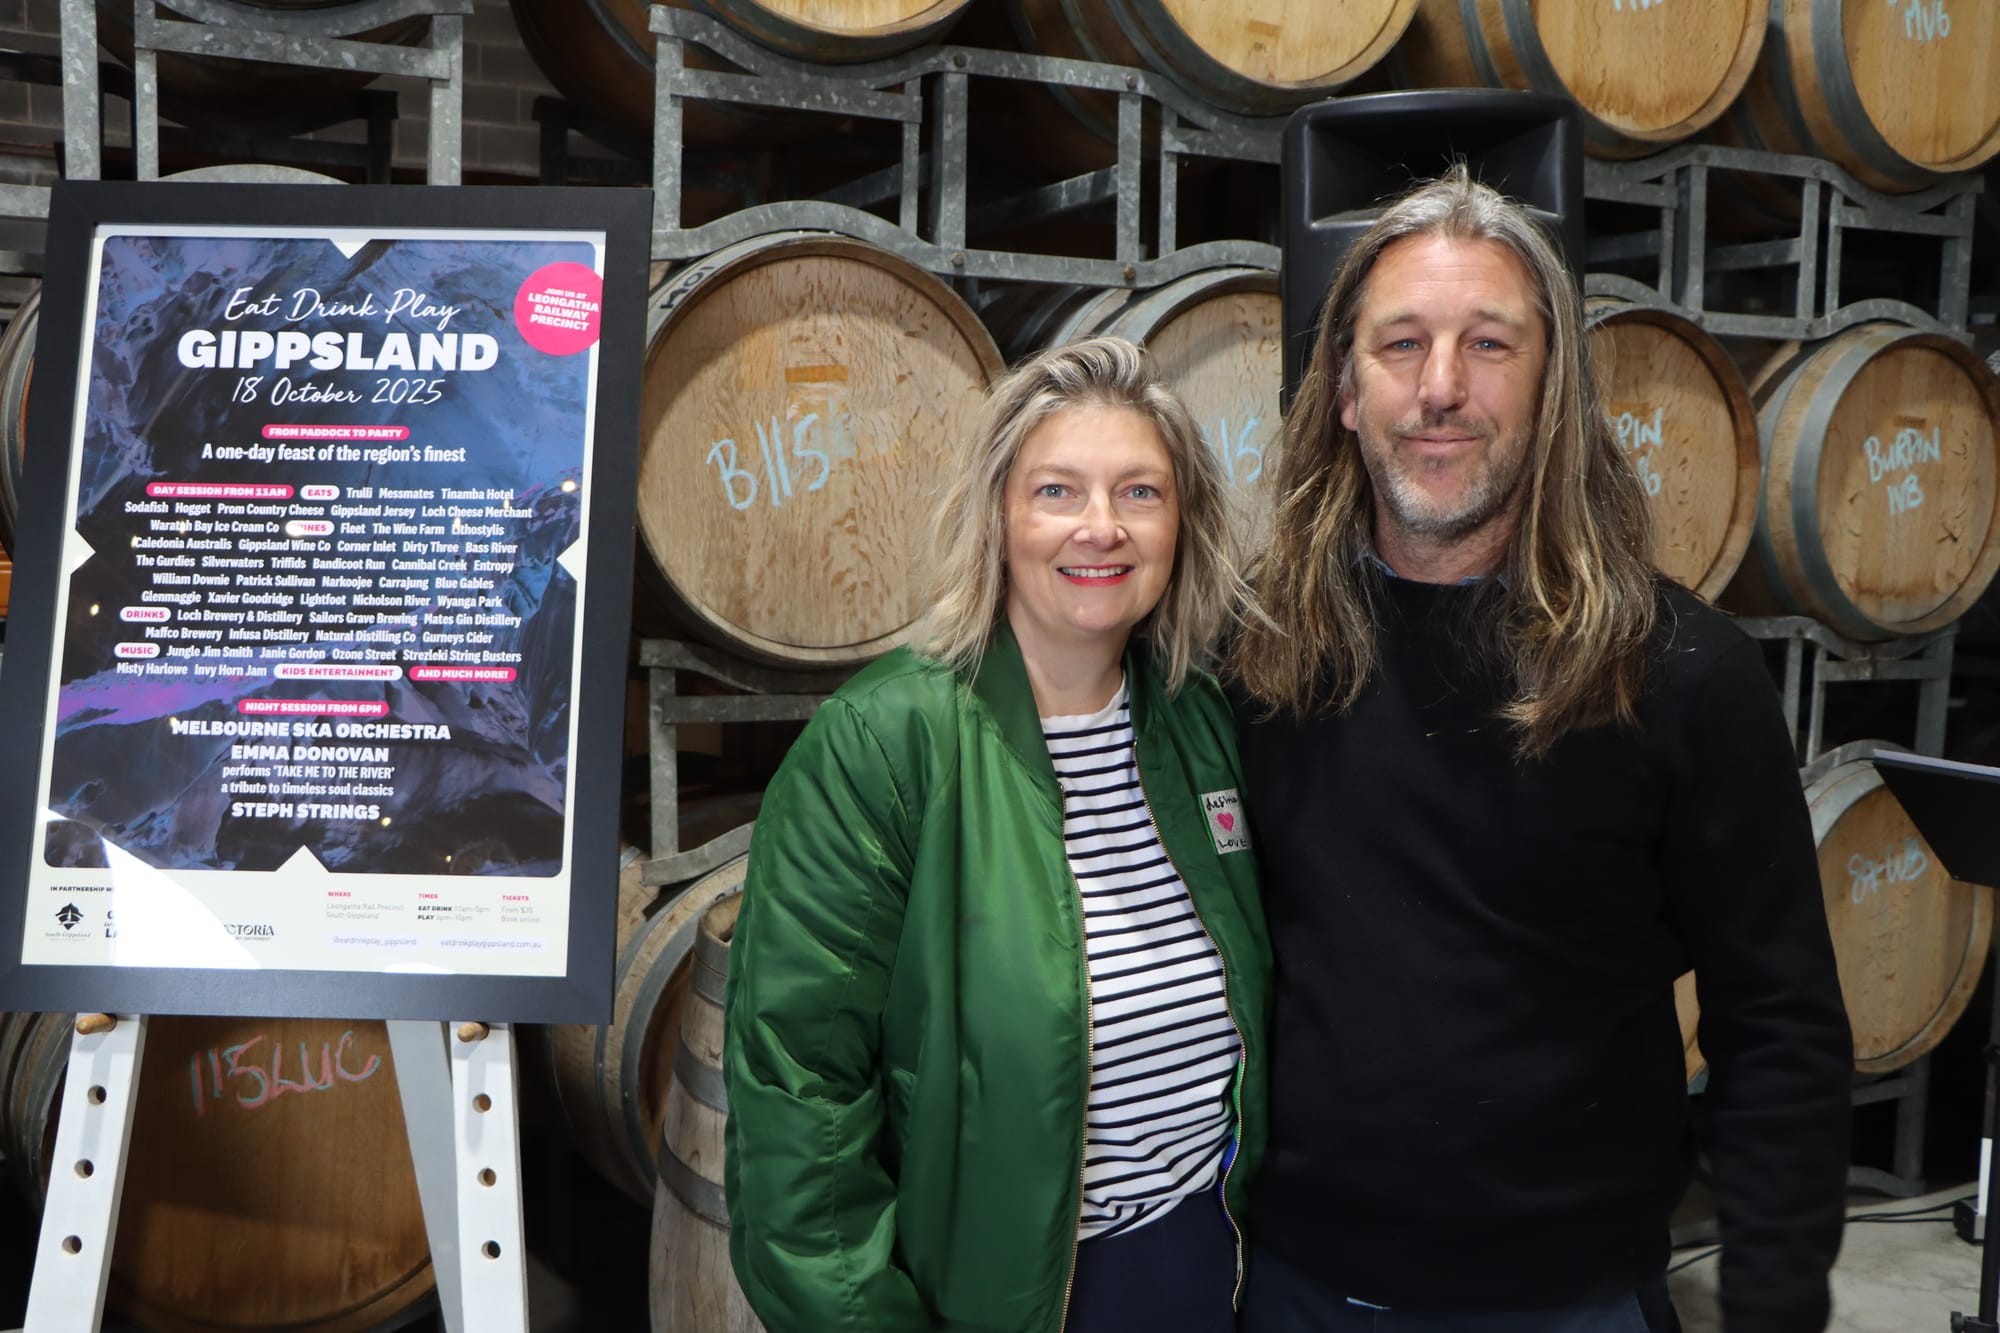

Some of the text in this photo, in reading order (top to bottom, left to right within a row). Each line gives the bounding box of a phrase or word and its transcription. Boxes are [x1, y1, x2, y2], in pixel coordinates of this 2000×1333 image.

[544, 288, 564, 296] JOIN
[224, 286, 460, 330] Eat Drink Play
[528, 292, 599, 312] LEONGATHA
[534, 304, 589, 320] RAILWAY
[530, 314, 589, 331] PRECINCT
[178, 330, 498, 371] GIPPSLAND
[232, 376, 446, 406] 18 October 2025
[268, 428, 403, 438] FROM PADDOCK TO PARTY
[1601, 406, 1663, 450] PIN
[202, 445, 212, 458] A
[216, 446, 274, 464] one-day
[278, 446, 314, 460] feast
[318, 446, 333, 460] of
[336, 446, 358, 461] the
[424, 448, 466, 462] finest
[154, 486, 287, 497] DAY SESSION FROM 11AM
[347, 488, 372, 498] Trulli
[379, 488, 434, 499] Messmates
[442, 488, 486, 500] Tinamba
[486, 489, 514, 500] Hotel
[125, 502, 532, 518] Sodafish Hogget Prom Country Cheese Gippsland Jersey Loch Cheese Merchant
[232, 521, 264, 532] Cream
[340, 523, 444, 535] Fleet Wine Farm
[186, 538, 232, 549] Australis
[238, 538, 289, 552] Gippsland
[292, 540, 316, 550] Wine
[337, 541, 371, 551] Corner
[374, 541, 396, 552] Inlet
[403, 542, 428, 554] Dirty
[430, 542, 459, 553] Three
[466, 542, 490, 553] Bass
[492, 542, 518, 553] River
[156, 556, 514, 573] Gurdies Silverwaters Triffids Bandicoot Cannibal Creek Entropy
[153, 573, 494, 590] William Downie Patrick Sullivan Narkoojee Carrajung Blue Gables
[142, 591, 502, 608] Glenmaggie Xavier Goodridge Lightfoot Nicholson River Wyanga Park
[178, 610, 201, 620] Loch
[204, 610, 245, 623] Brewery
[256, 611, 303, 624] Distillery
[310, 612, 344, 623] Sailors
[346, 613, 375, 624] Grave
[376, 614, 417, 626] Brewing
[424, 614, 454, 625] Mates
[474, 615, 521, 628] Distillery
[180, 628, 493, 645] Brewery Infusa Distillery Natural Distilling Gurneys Cider
[166, 646, 200, 659] Jungle
[223, 647, 253, 657] Smith
[260, 648, 288, 659] Janie
[290, 648, 325, 659] Gordon
[332, 649, 363, 660] Ozone
[365, 649, 396, 660] Street
[450, 650, 480, 663] String
[483, 651, 521, 662] Busters
[117, 663, 144, 675] Misty
[146, 664, 188, 675] Harlowe
[218, 665, 244, 676] Horn
[245, 665, 267, 676] Jam
[309, 668, 393, 676] ENTERTAINMENT
[442, 670, 474, 678] MUCH
[475, 670, 508, 678] MORE!
[245, 702, 382, 713] NIGHT SESSION FROM 6PM
[172, 720, 451, 740] MELBOURNE SKA ORCHESTRA
[232, 745, 389, 762] EMMA DONOVAN
[222, 765, 336, 779] performs TO
[230, 782, 393, 796] tribute timeless soul classics
[232, 802, 380, 820] STEPH STRINGS
